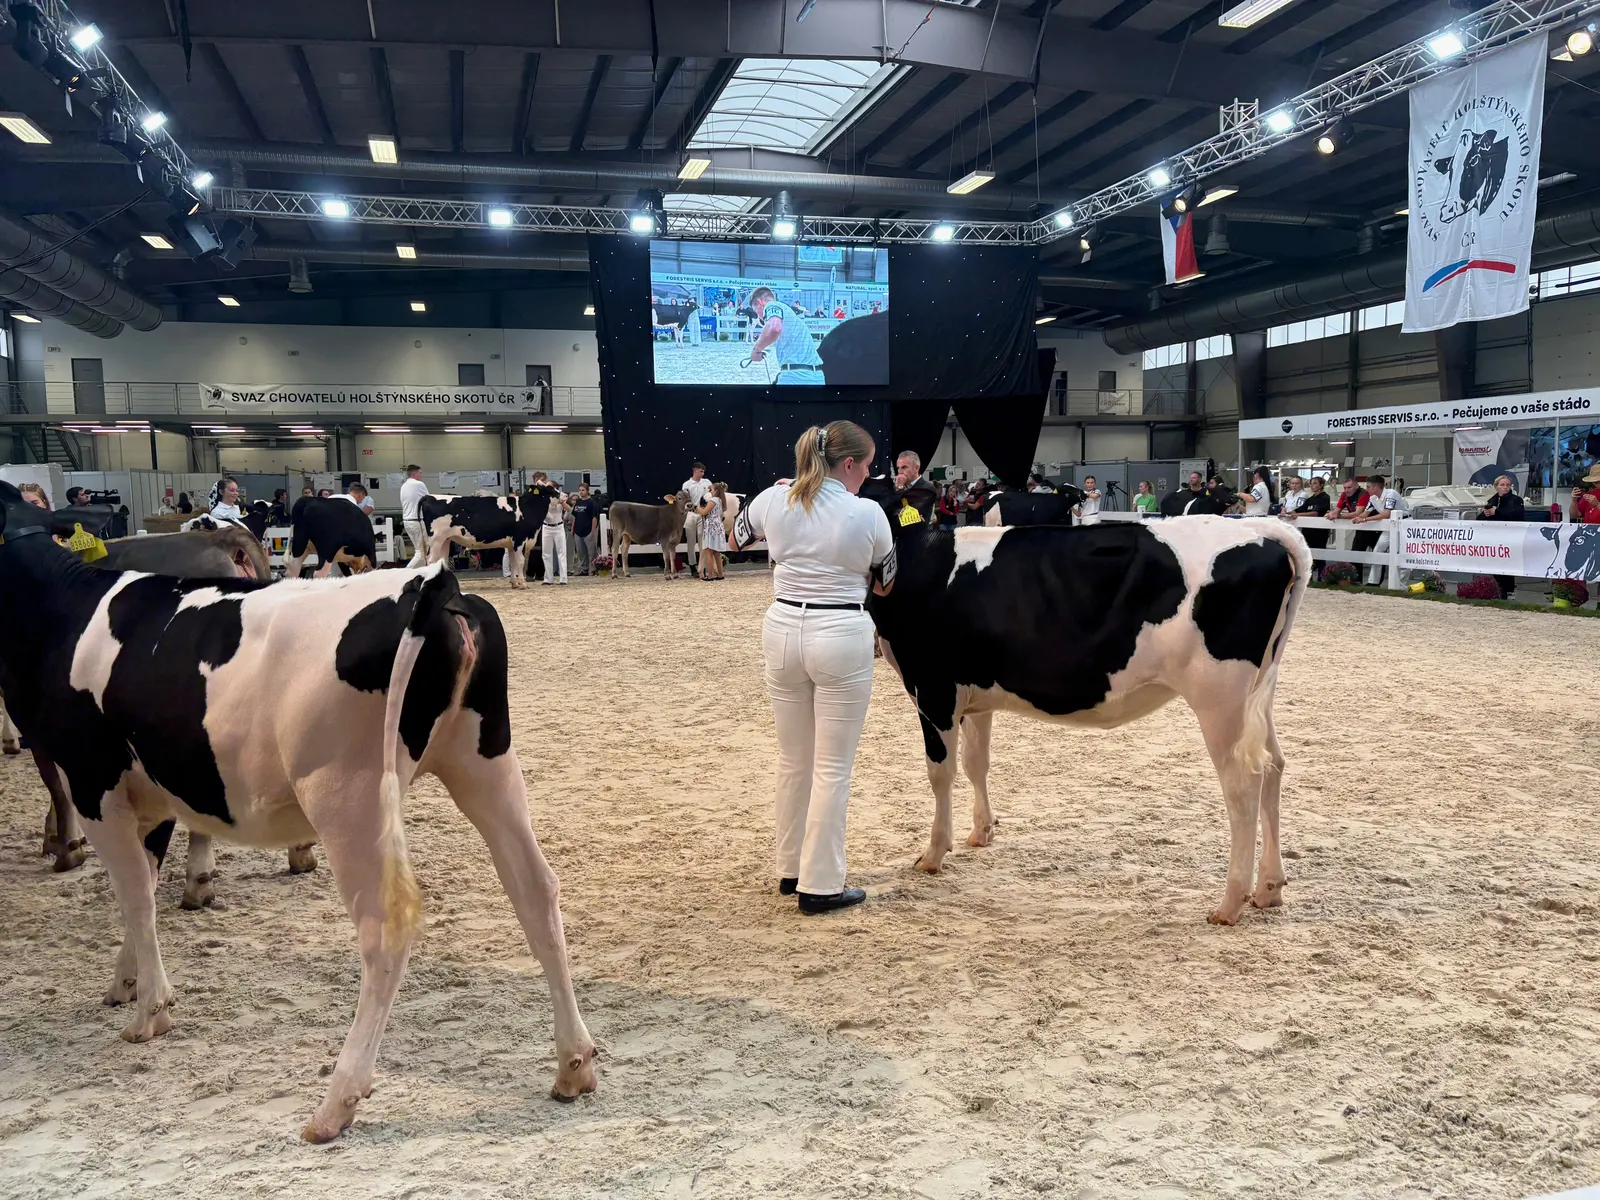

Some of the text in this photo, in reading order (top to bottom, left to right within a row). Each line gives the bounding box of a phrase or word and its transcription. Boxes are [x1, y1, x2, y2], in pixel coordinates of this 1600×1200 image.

[1420, 212, 1441, 242] SVAZ
[1454, 94, 1532, 158] HOLŠTÝNSKÉHO
[1499, 164, 1531, 222] SKOTU
[231, 391, 515, 404] SVAZ CHOVATELŮ HOLŠTÝNSKÉHO SKOTU ČR
[1327, 415, 1377, 428] FORESTRIS
[1378, 412, 1413, 424] SERVIS
[1414, 412, 1440, 422] s.r.o.
[1452, 405, 1508, 419] Pečujeme
[1511, 405, 1518, 414] o
[1520, 399, 1549, 413] vaše
[1552, 396, 1591, 411] stádo
[1406, 527, 1474, 541] SVAZ CHOVATELŮ
[1406, 541, 1511, 558] HOLŠTÝNSKÉHO SKOTU ČR
